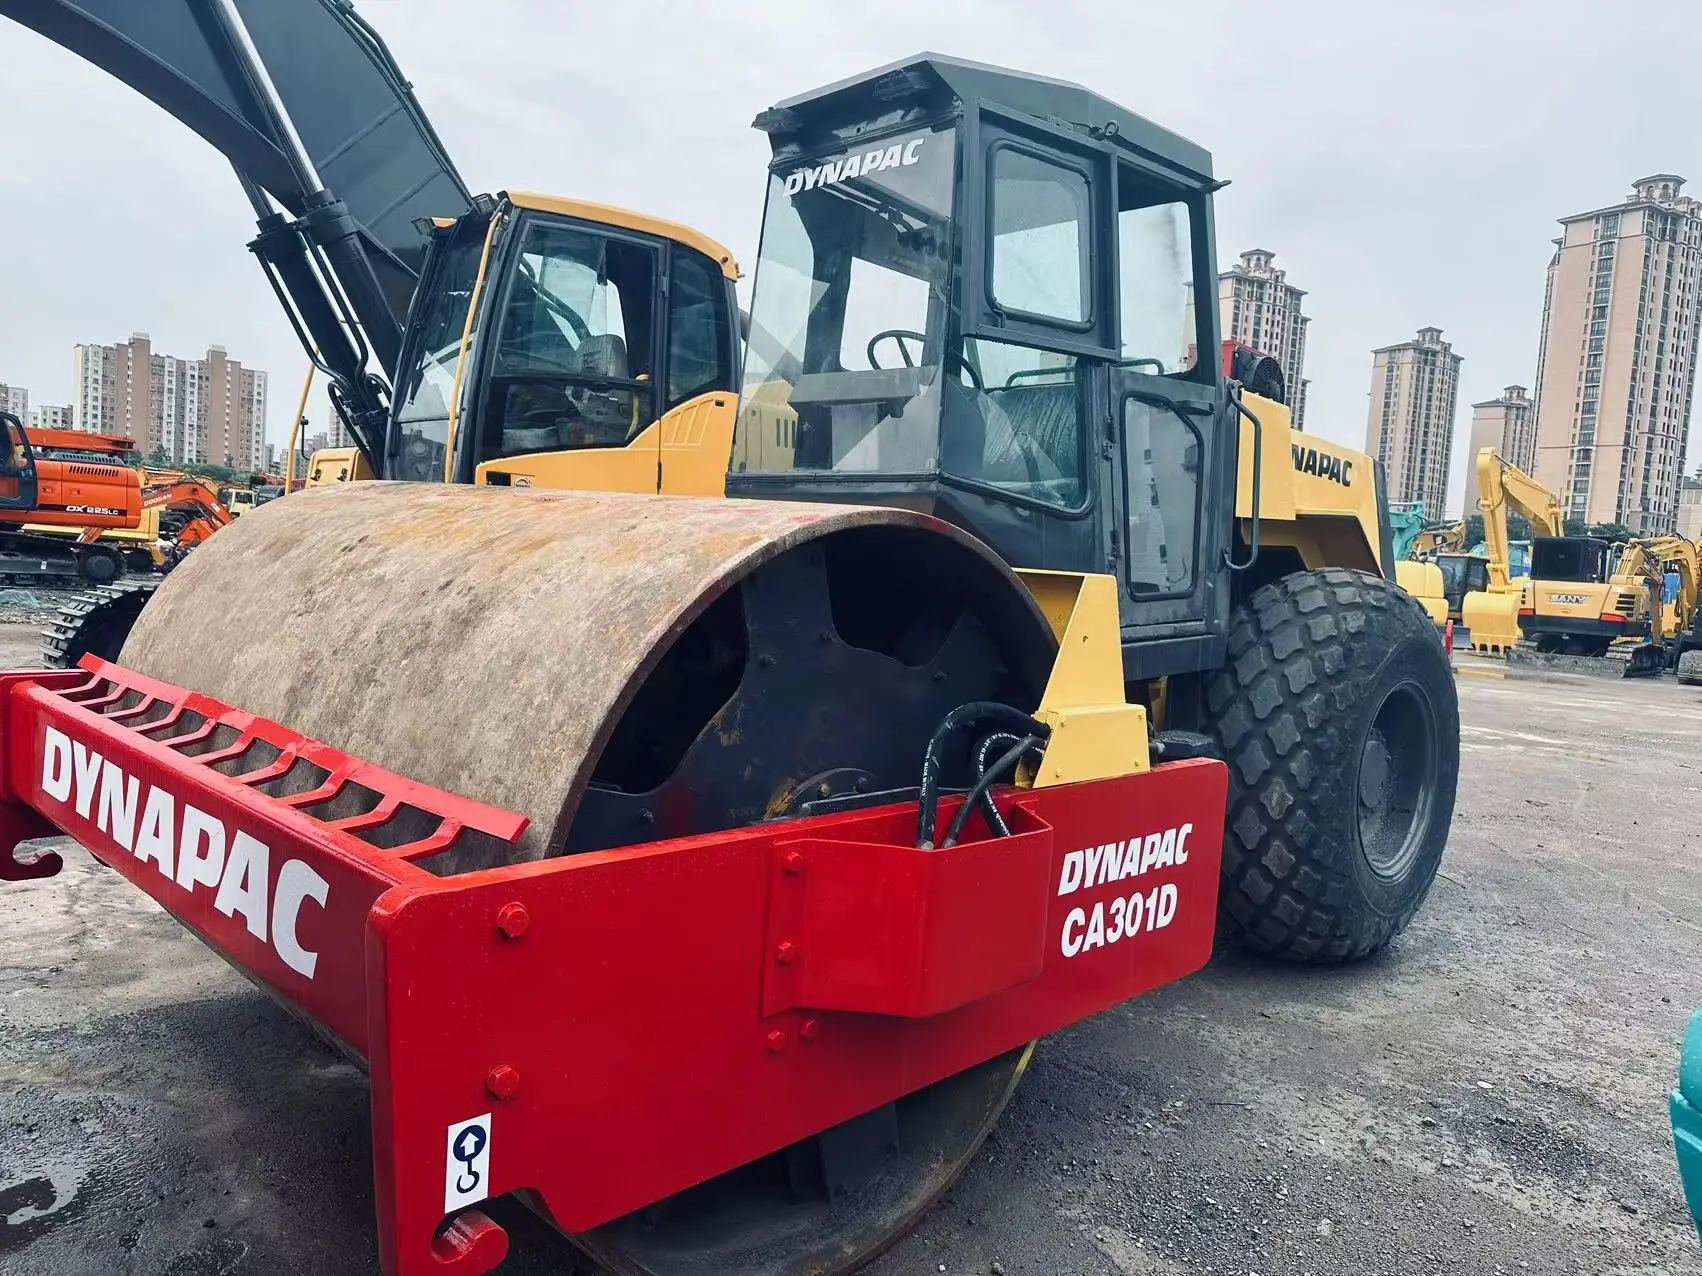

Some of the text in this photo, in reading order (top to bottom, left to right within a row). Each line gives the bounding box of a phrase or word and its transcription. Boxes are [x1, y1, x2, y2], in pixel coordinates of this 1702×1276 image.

[784, 138, 925, 197] DYNAPAC
[87, 506, 119, 515] 225LC
[143, 494, 172, 506] DOOSAN
[42, 726, 329, 979] DYNAPAC
[1057, 823, 1193, 896] DYNAPAC
[1061, 884, 1178, 957] CA301D
